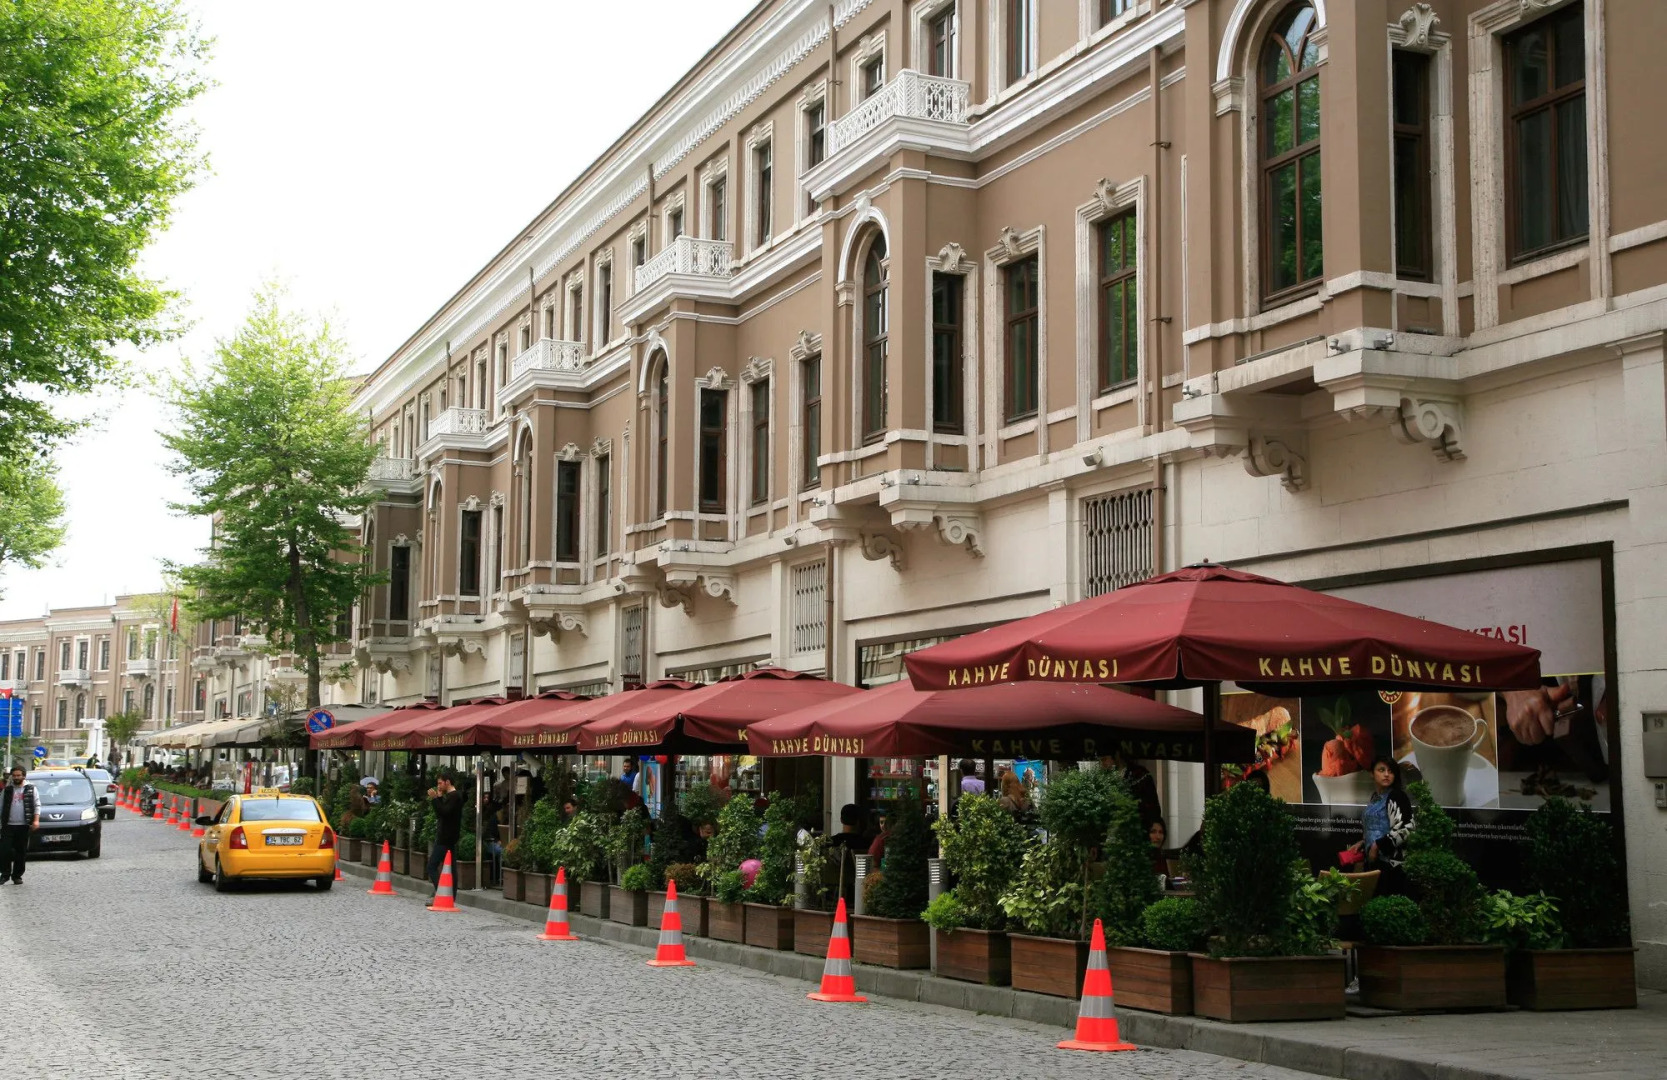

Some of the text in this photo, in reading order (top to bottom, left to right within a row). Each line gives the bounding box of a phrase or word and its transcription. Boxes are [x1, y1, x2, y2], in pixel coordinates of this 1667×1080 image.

[948, 655, 1118, 686] KAHVE DÜNYASI
[1258, 653, 1481, 683] KAHVE DÜNYASI
[424, 736, 439, 745] KAHVE
[513, 731, 569, 745] KAHVE DÜNYASI
[595, 729, 658, 747] KAHVE DÜNYASI
[772, 734, 864, 754] KAHVE DÜNYASI
[971, 738, 1193, 757] KAHVE DNYASI
